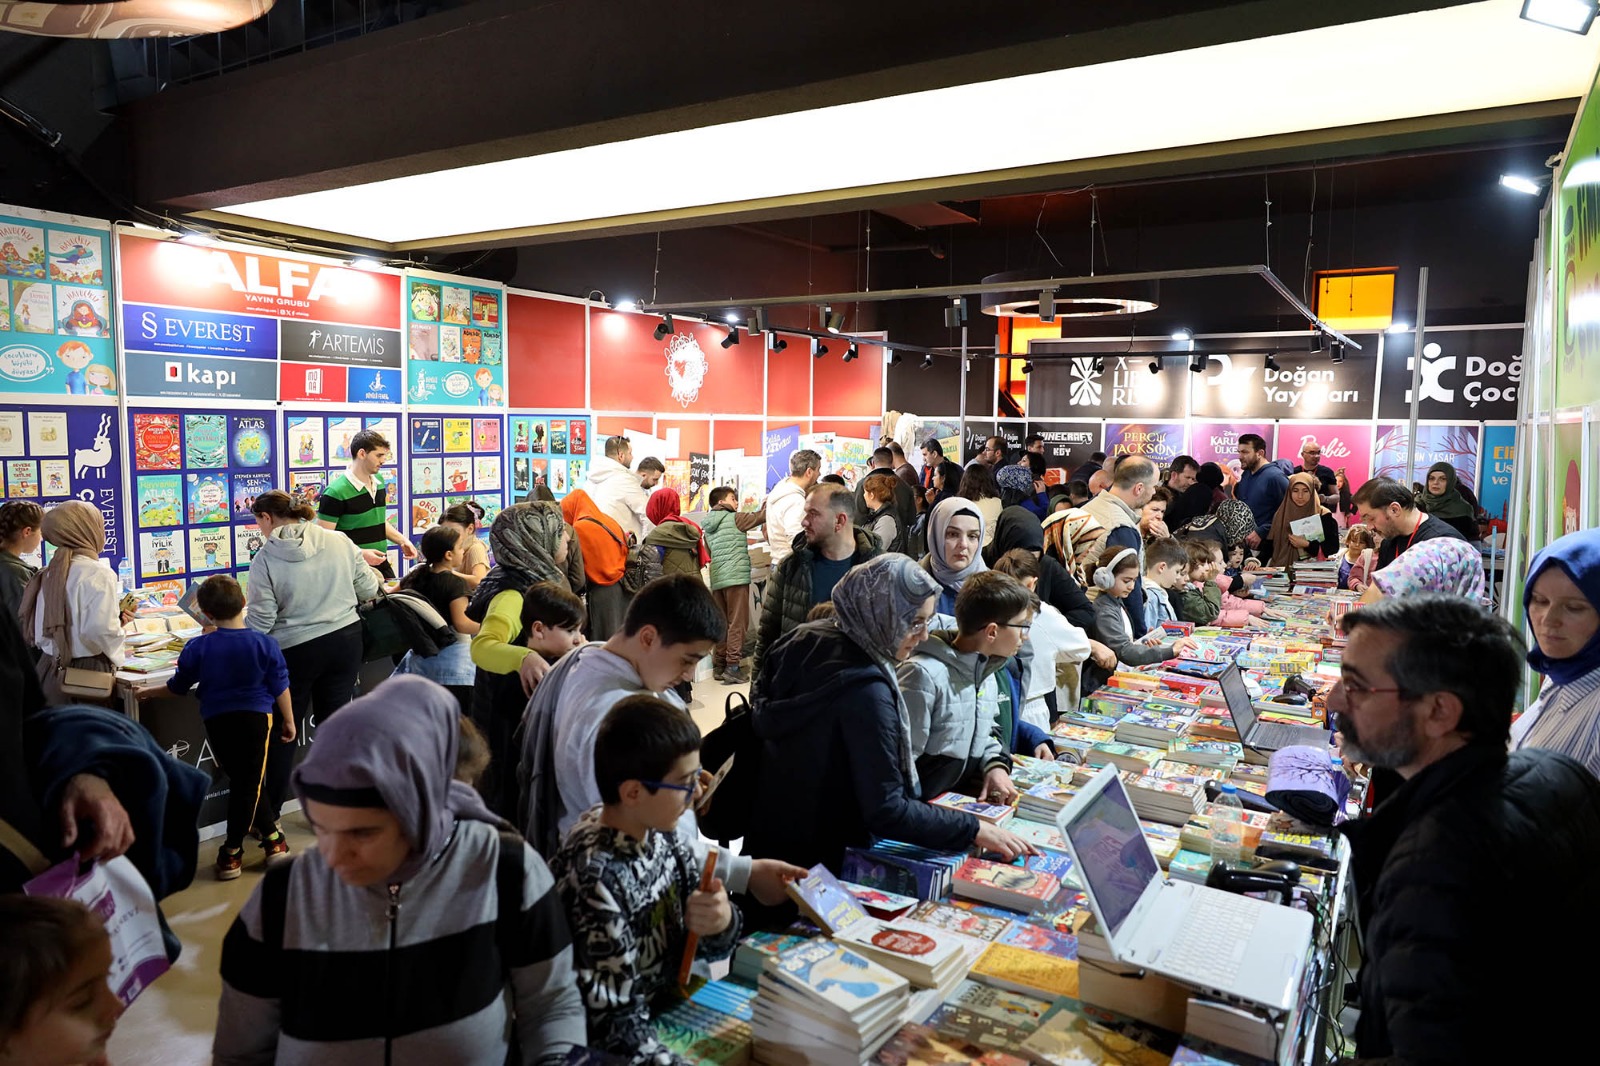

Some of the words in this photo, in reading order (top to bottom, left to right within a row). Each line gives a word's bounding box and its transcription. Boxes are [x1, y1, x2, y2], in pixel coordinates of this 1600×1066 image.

[244, 294, 274, 305] YAYIN
[276, 297, 310, 308] GRUBU
[163, 317, 256, 343] EVEREST
[322, 333, 385, 355] ARTEMİS
[187, 362, 236, 390] kapı
[1264, 366, 1334, 388] Doğan
[1465, 355, 1523, 382] Doğ
[1263, 386, 1359, 408] Yayarı
[1463, 381, 1520, 408] Çoc
[238, 420, 265, 429] ATLAS
[1114, 443, 1177, 456] JACKSON
[1297, 434, 1351, 459] Brbie
[1492, 476, 1508, 485] ve
[100, 488, 118, 556] EVEREST
